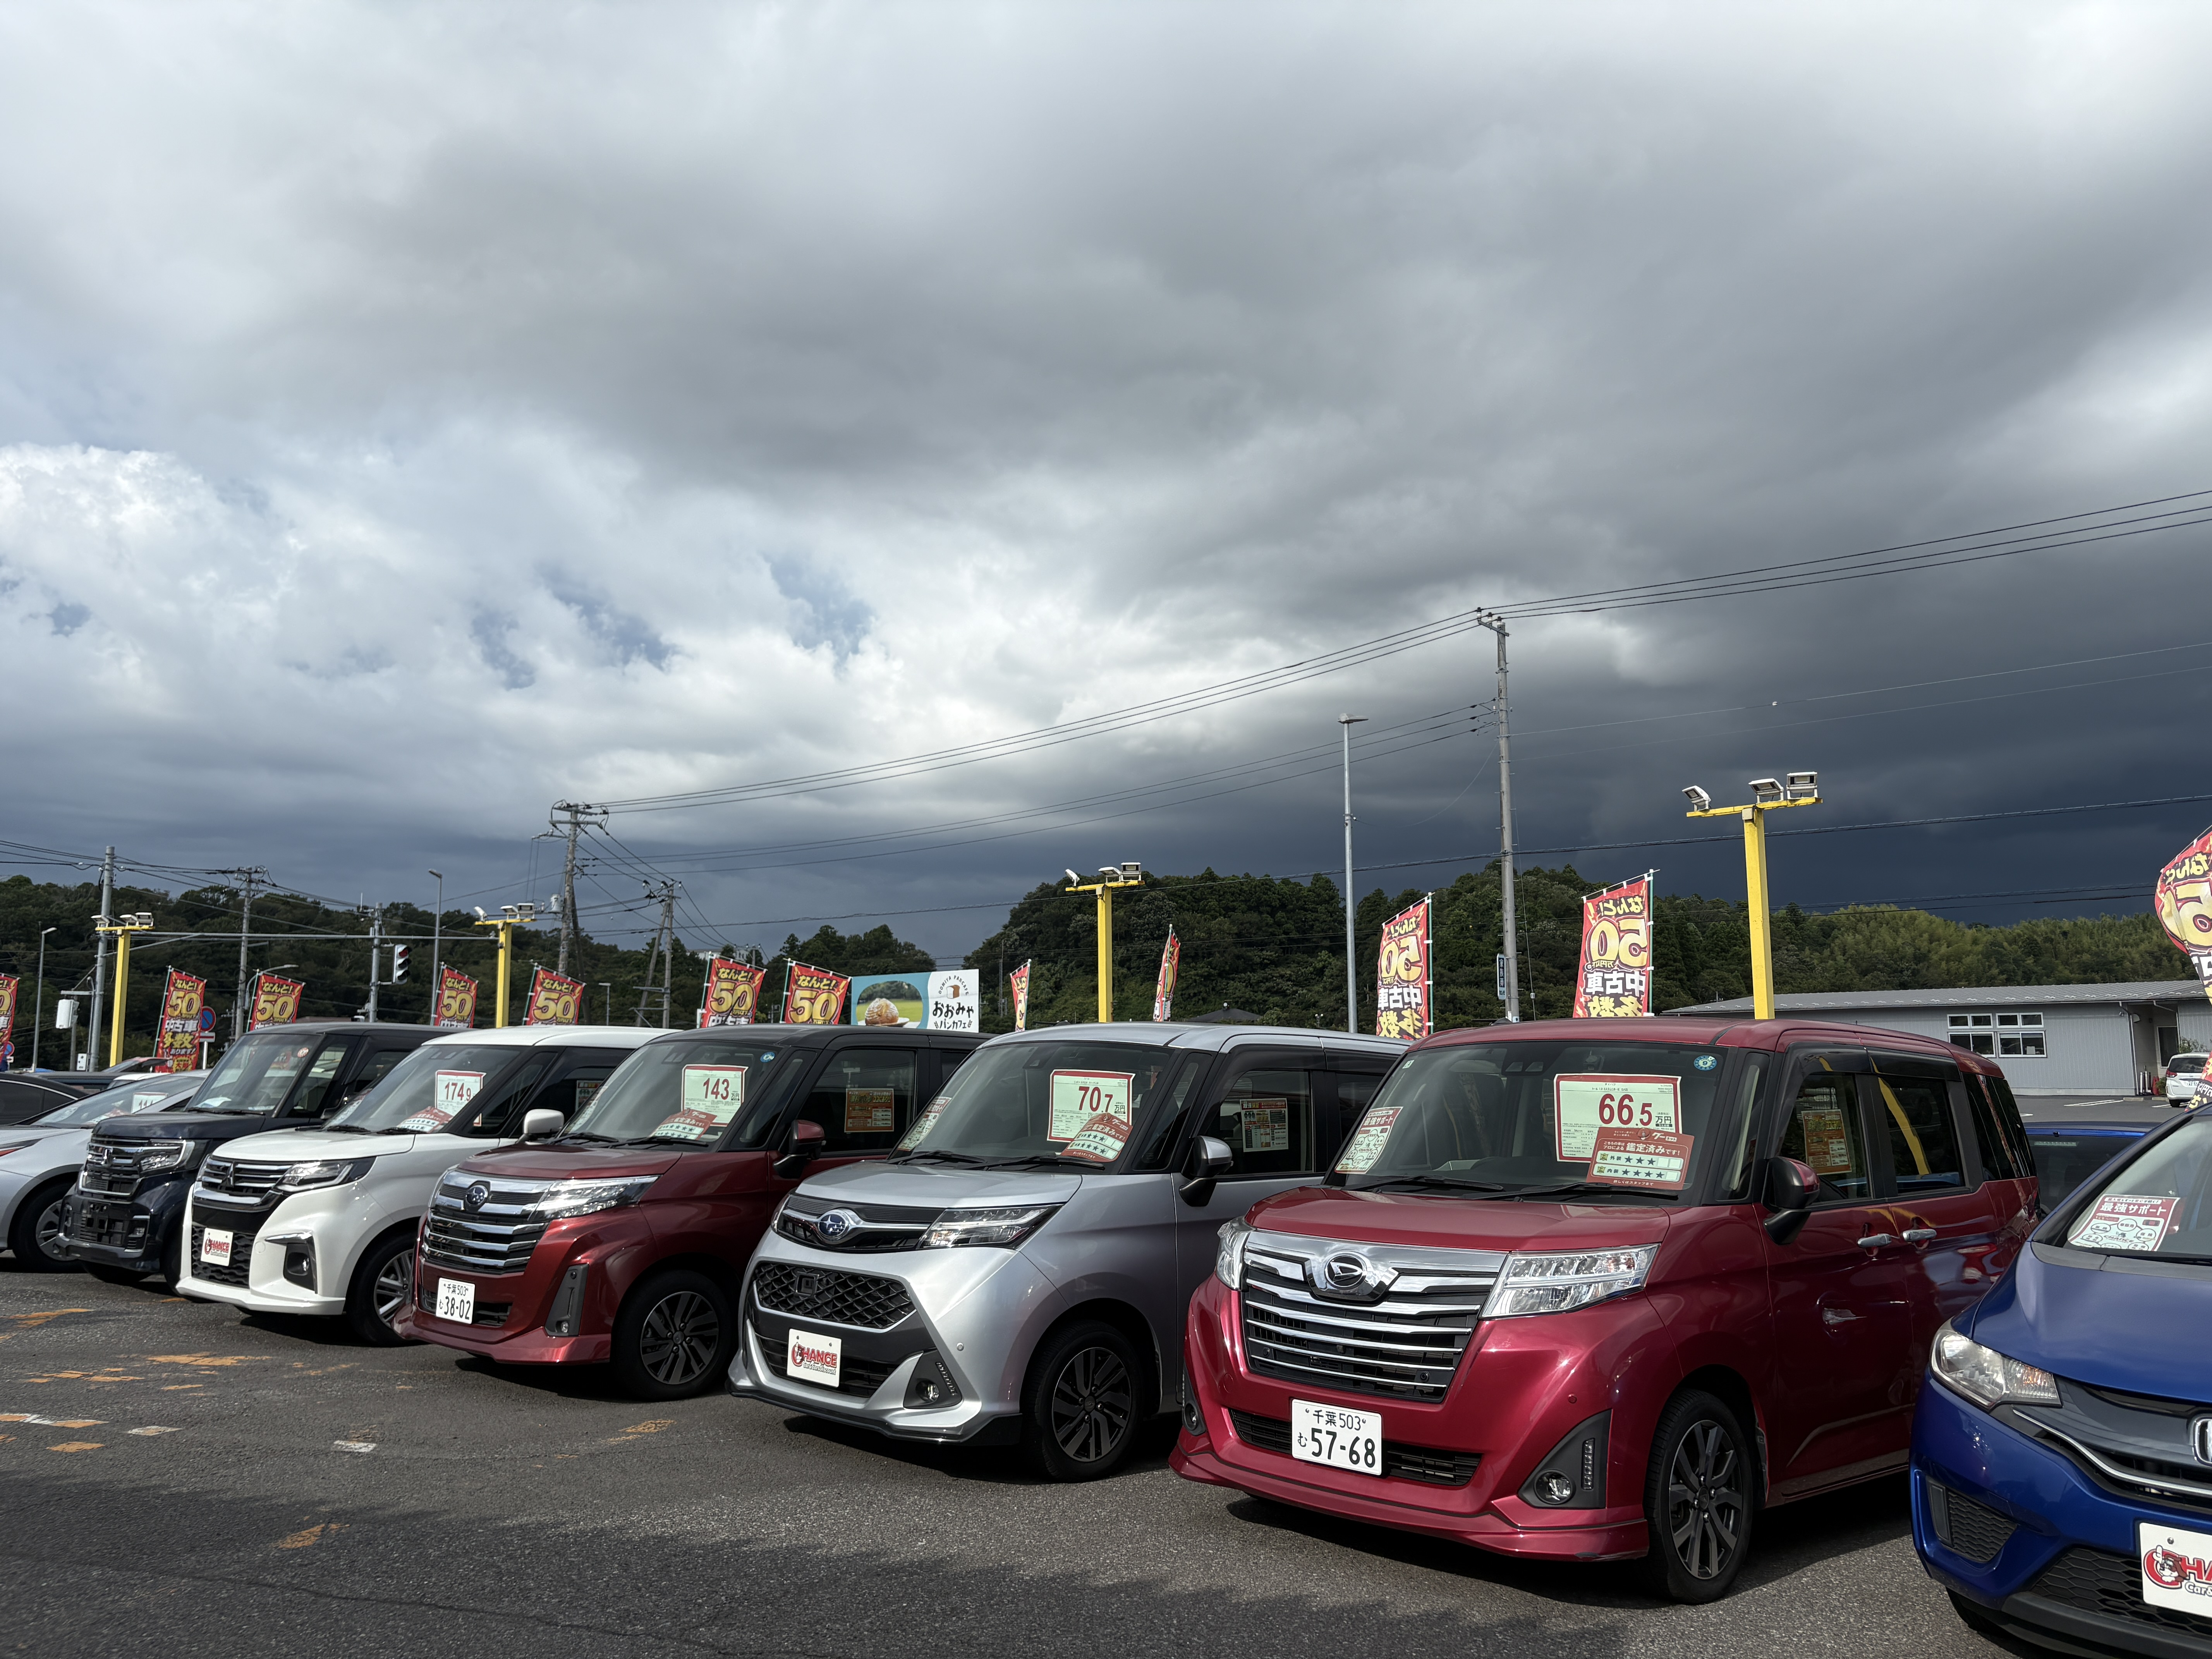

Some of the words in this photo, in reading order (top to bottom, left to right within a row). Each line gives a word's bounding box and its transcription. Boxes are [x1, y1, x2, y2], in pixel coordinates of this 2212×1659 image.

[718, 967, 753, 981] なんと!
[797, 974, 837, 989] なんと!
[263, 982, 293, 994] なんと!
[938, 976, 951, 994] OOMIYA
[954, 975, 969, 996] PANCAFE
[168, 990, 201, 1017] 50
[256, 994, 294, 1021] 50
[441, 989, 473, 1018] 50
[533, 991, 575, 1020] 50
[710, 982, 754, 1013] 50
[790, 990, 838, 1024] 50
[933, 1001, 974, 1019] おおみや
[165, 1019, 199, 1032] 中古車
[939, 1018, 967, 1030] パンカフェ
[445, 1082, 471, 1101] 174.9
[703, 1077, 730, 1100] 143
[1599, 1094, 1652, 1126] 66.5
[1655, 1116, 1671, 1124] 万円
[1363, 1116, 1393, 1126] 最強サポート
[2100, 1202, 2167, 1216] 最強サポート
[791, 1343, 837, 1369] CHANCE
[1313, 1409, 1337, 1427] 千葉
[1339, 1413, 1361, 1431] 503
[1297, 1432, 1307, 1448] む
[1311, 1427, 1376, 1468] 57-68
